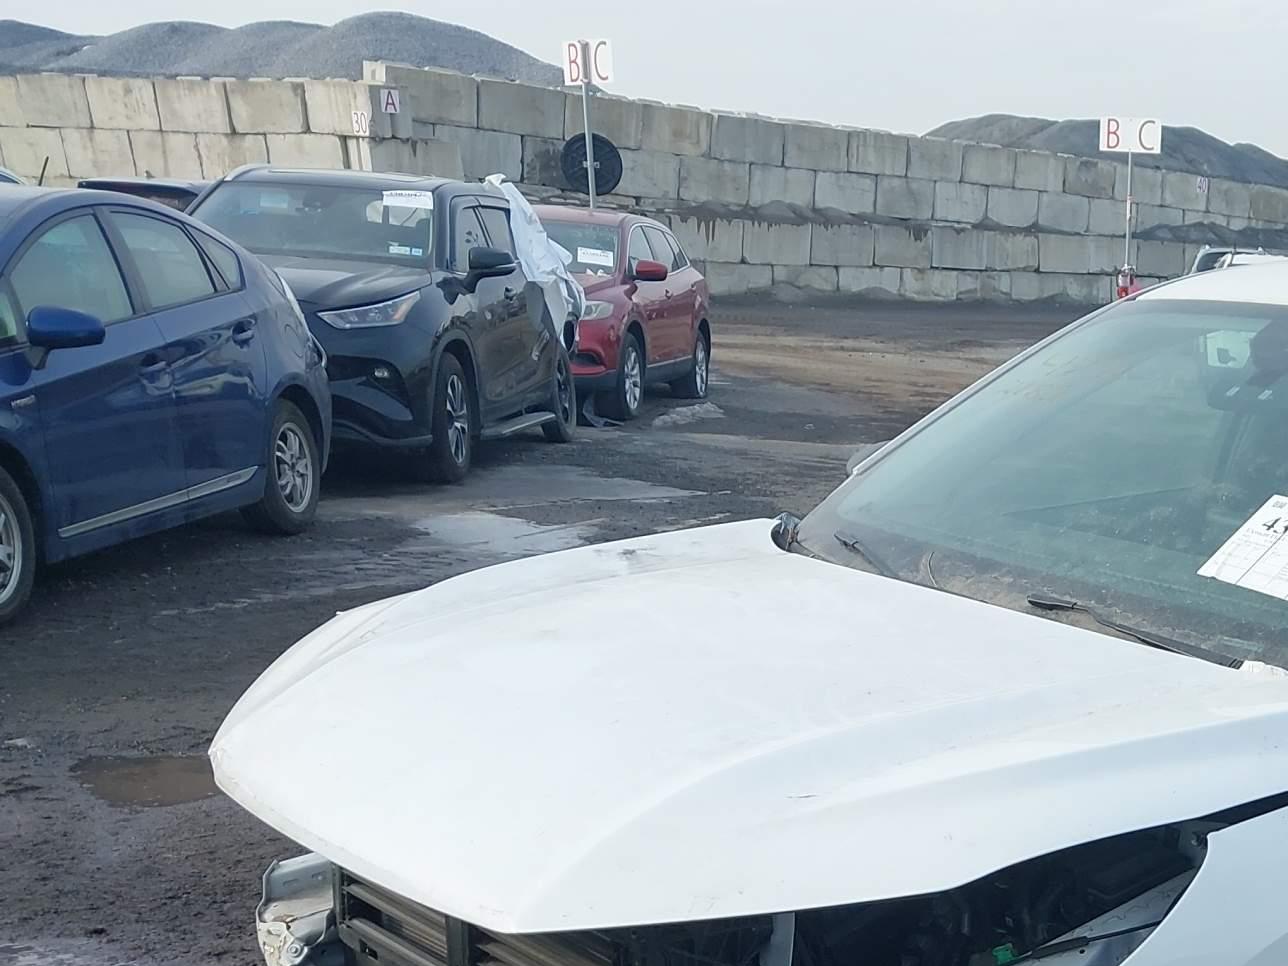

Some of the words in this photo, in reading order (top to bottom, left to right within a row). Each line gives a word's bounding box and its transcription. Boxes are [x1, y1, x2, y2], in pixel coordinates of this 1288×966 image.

[568, 43, 580, 82] B
[594, 40, 609, 81] C
[384, 90, 398, 113] A
[353, 112, 367, 134] 30
[1107, 118, 1120, 149] B
[1138, 120, 1156, 151] C
